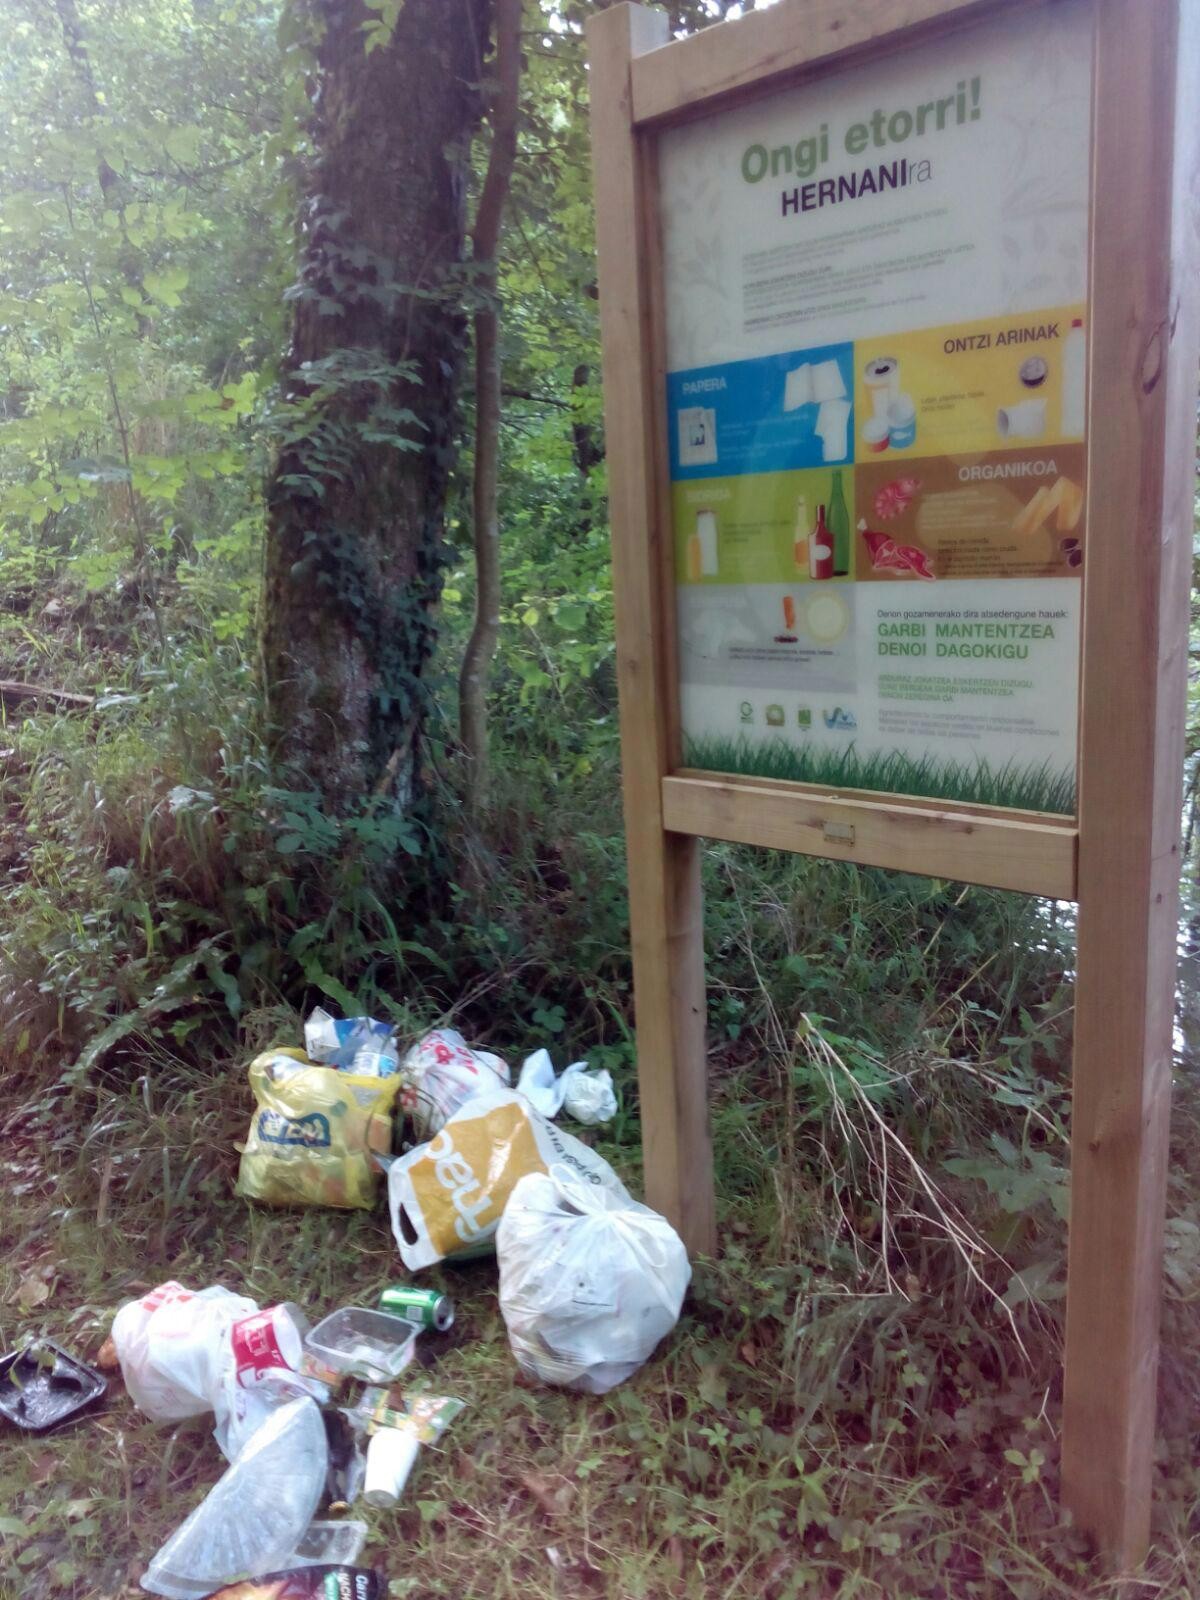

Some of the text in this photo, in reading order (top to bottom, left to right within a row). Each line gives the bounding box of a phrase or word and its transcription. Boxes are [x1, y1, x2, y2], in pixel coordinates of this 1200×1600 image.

[741, 76, 981, 184] Ongi etorri!
[781, 158, 932, 217] HERNANIra
[943, 323, 1060, 354] ONTZI ARINAK
[682, 376, 728, 394] PAPERA
[958, 459, 1058, 480] ORGANIKOA
[878, 623, 1055, 639] GARBI MANTENTZEA
[878, 642, 1029, 659] DENOI DAGOKIGU
[423, 1128, 502, 1242] fnac
